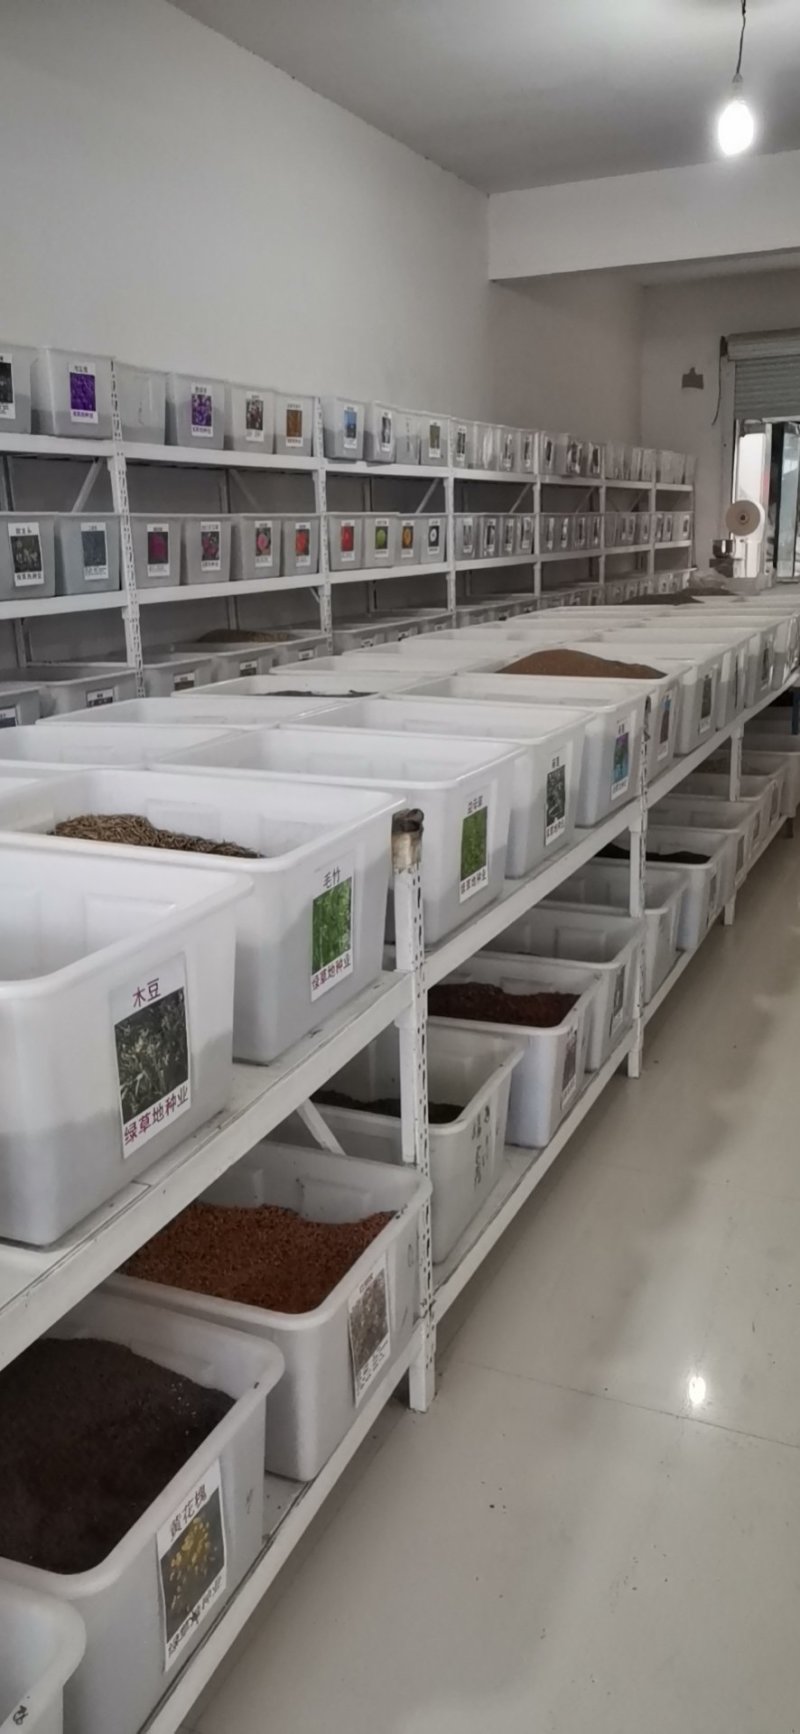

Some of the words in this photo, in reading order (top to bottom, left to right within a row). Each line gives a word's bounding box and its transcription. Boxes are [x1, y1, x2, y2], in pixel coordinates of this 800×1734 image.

[322, 866, 341, 889] 毛竹
[311, 953, 351, 991] 绿草地种业
[132, 978, 162, 1008] 木豆
[124, 1086, 189, 1146] 绿草地种业
[169, 1484, 208, 1542] 黄花槐
